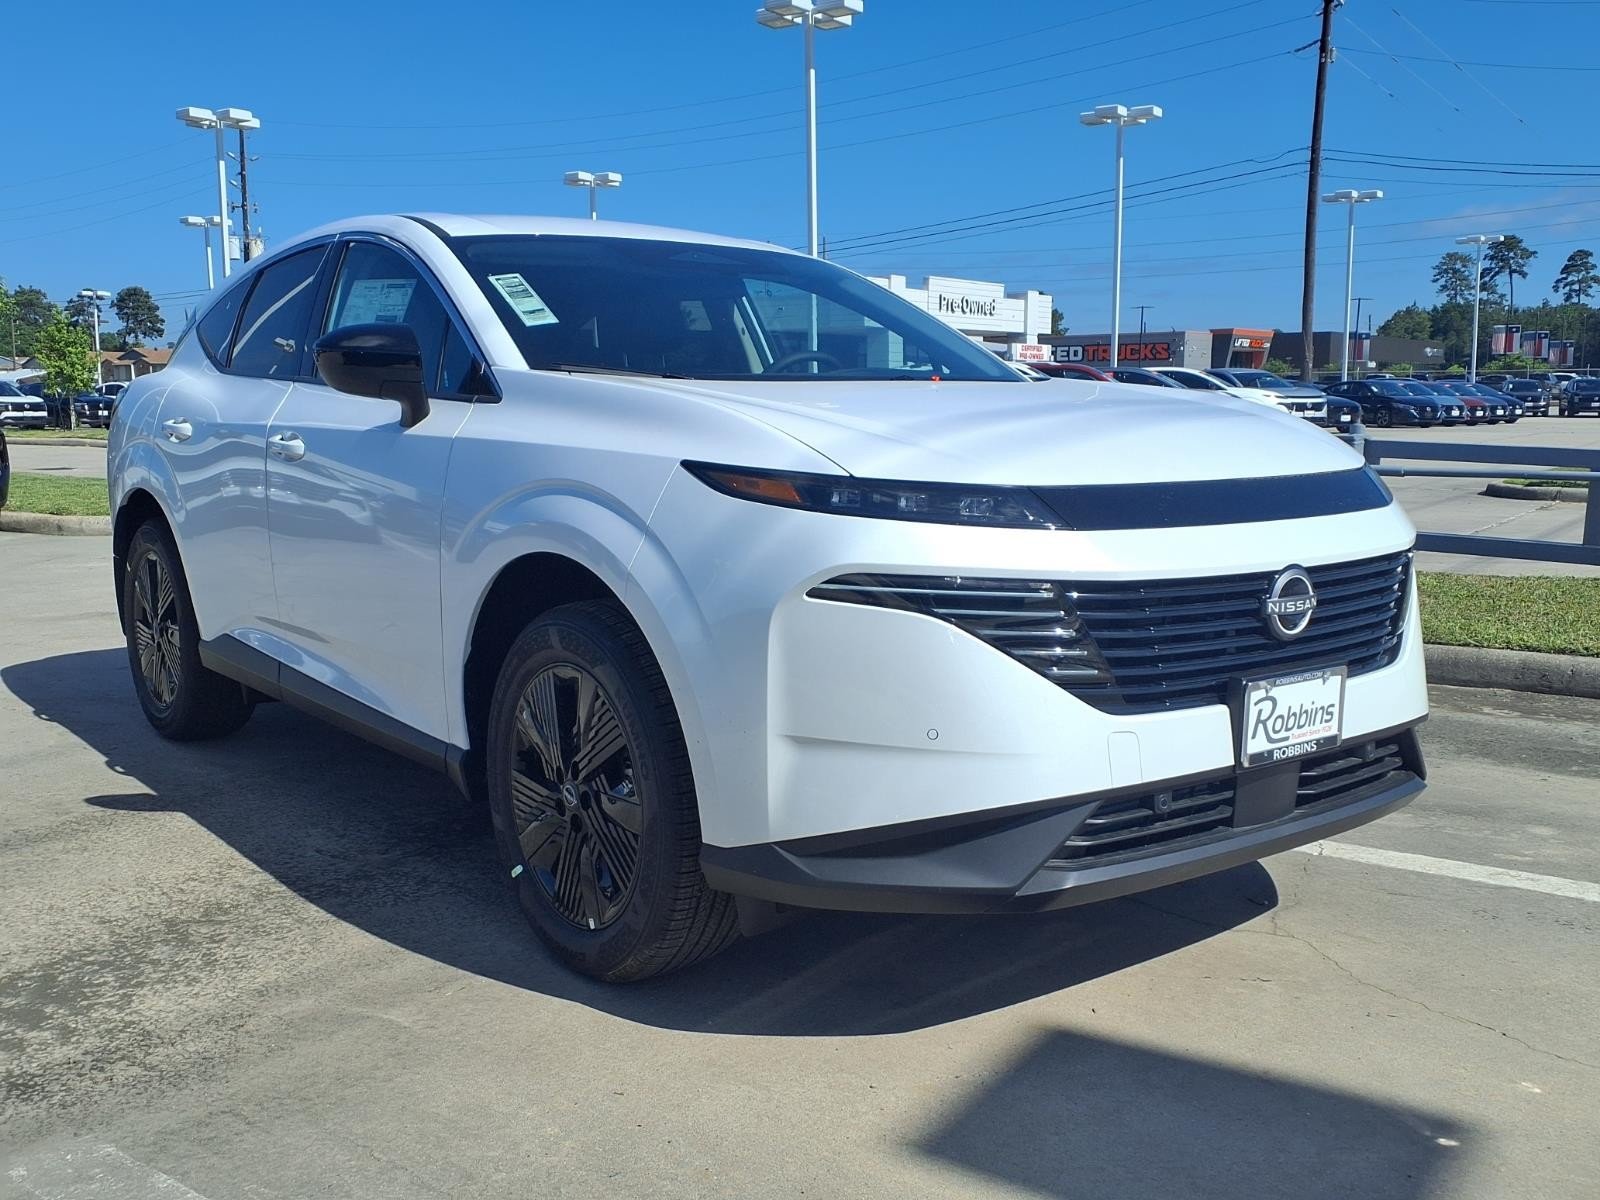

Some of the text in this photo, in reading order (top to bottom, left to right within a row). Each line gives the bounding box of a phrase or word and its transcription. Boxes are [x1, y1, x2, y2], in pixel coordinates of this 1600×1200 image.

[938, 294, 996, 316] Pre-Owned
[1268, 596, 1317, 613] NISSAN
[1251, 695, 1336, 744] Robbins
[1273, 740, 1317, 760] ROBBINS
